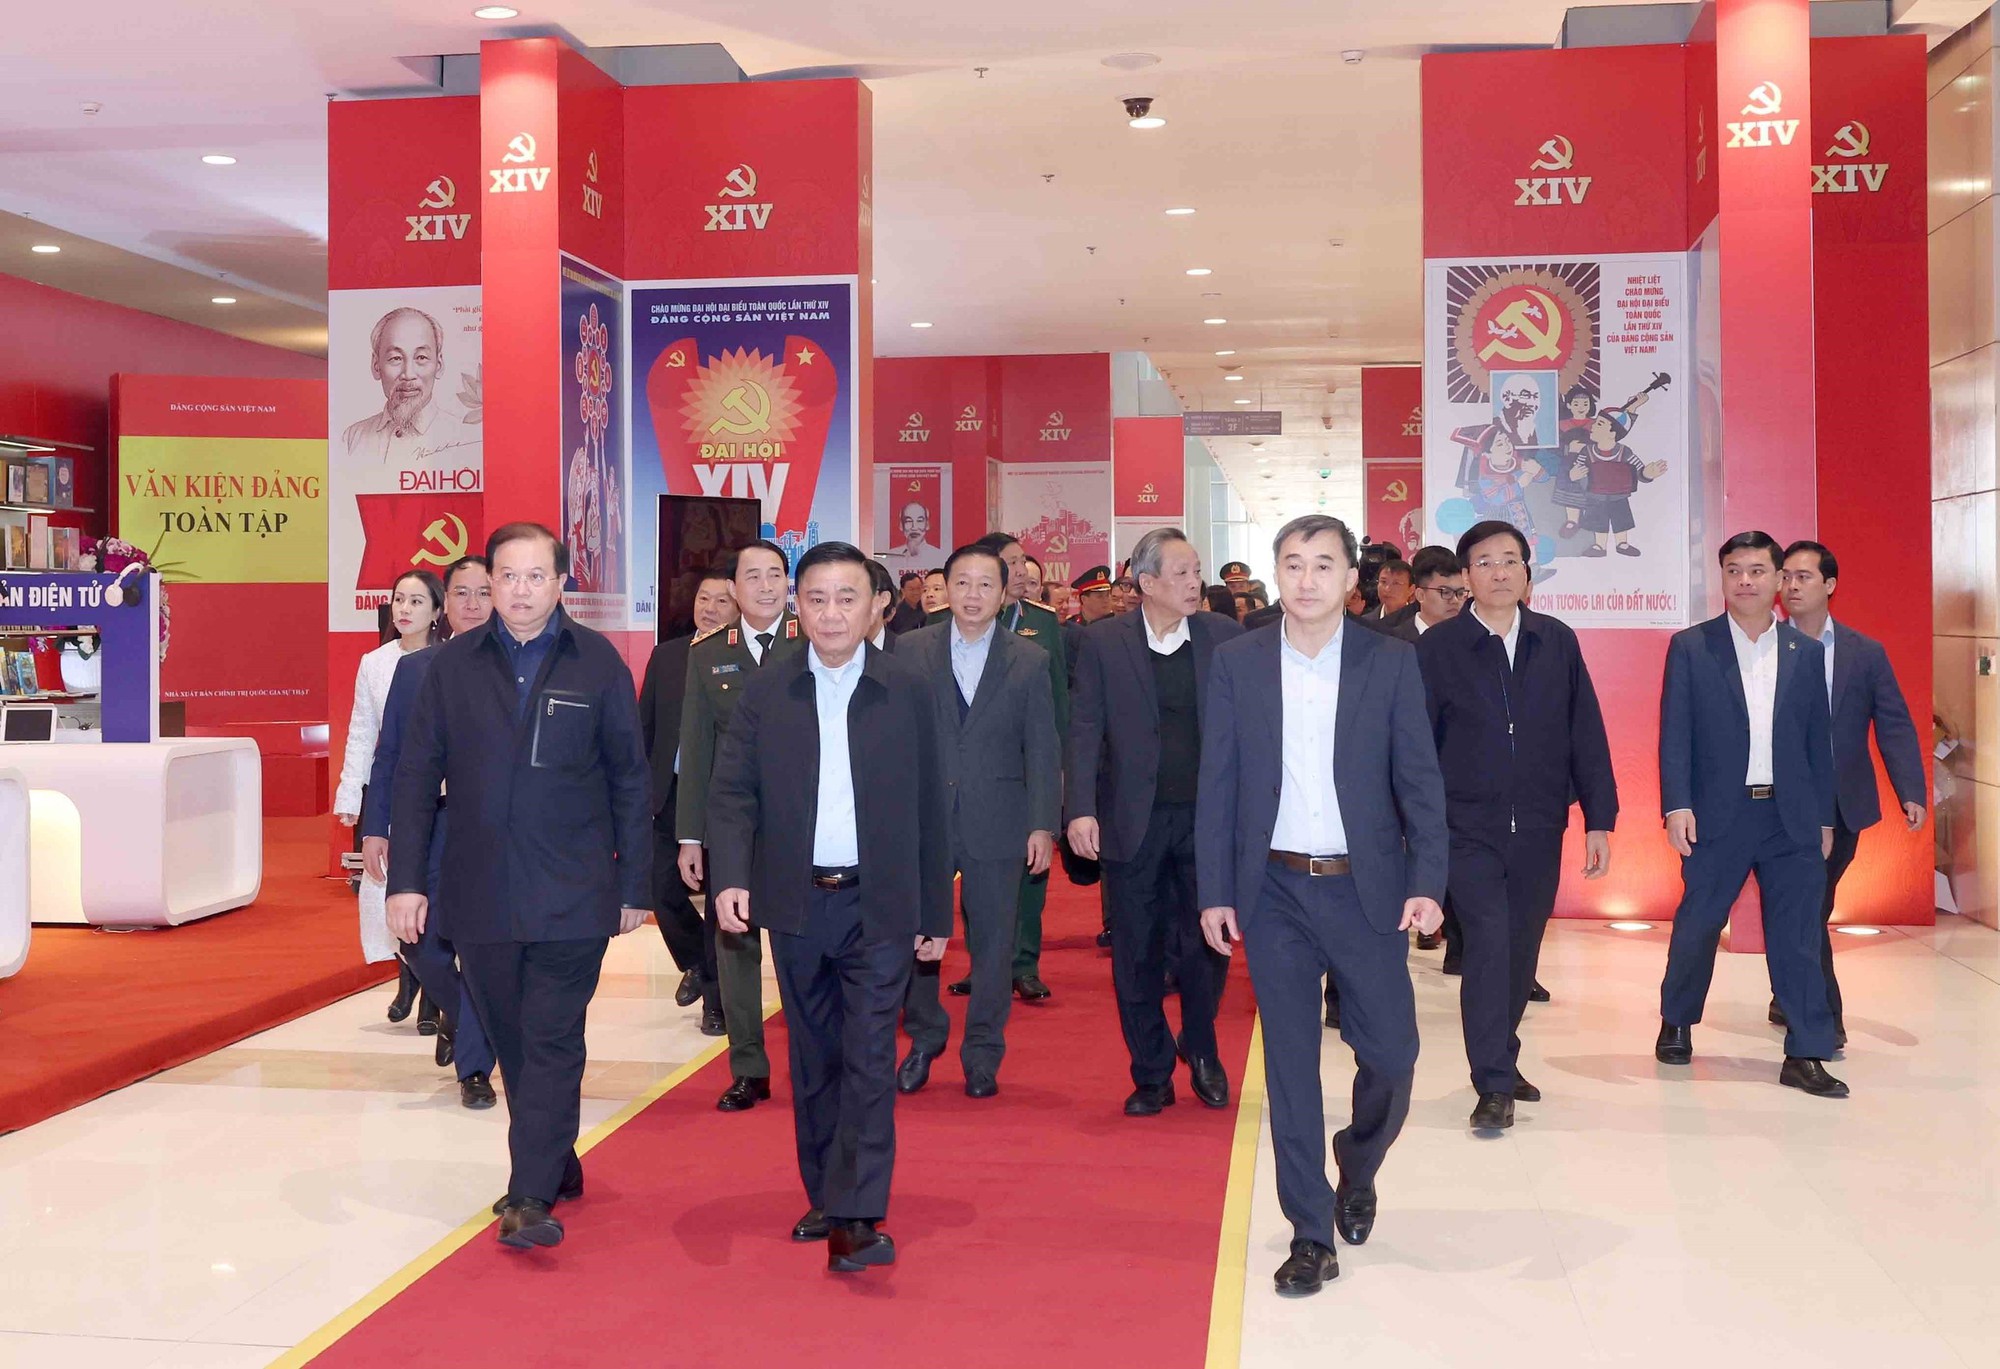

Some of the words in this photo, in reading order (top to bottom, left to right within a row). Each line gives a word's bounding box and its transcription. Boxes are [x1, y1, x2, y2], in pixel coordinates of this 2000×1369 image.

[1726, 119, 1800, 148] XIV
[489, 167, 551, 193] XIV
[1811, 163, 1889, 193] XIV
[582, 184, 603, 219] XIV
[1514, 176, 1592, 206] XIV
[405, 214, 472, 241] XIV
[704, 203, 774, 231] XIV
[1627, 275, 1646, 285] NHIỆT
[1647, 274, 1661, 285] LIỆT
[1625, 287, 1642, 296] CHÀO
[650, 314, 689, 324] ĐẢNG
[693, 313, 731, 325] CỘNG
[735, 311, 762, 322] SẢN
[765, 311, 795, 323] VIỆT
[800, 311, 830, 320] NAM
[651, 303, 669, 313] CHÀO
[670, 302, 691, 313] MỪNG
[692, 304, 704, 314] ĐẠI
[705, 303, 717, 314] HỘI
[718, 303, 730, 313] ĐẠI
[749, 300, 767, 311] TOÀN
[768, 299, 787, 311] QUỐC
[818, 300, 829, 309] XIV
[170, 403, 194, 411] ĐẢNG
[195, 404, 219, 413] CỘNG
[237, 404, 257, 414] VIỆT
[257, 405, 276, 413] NAM
[899, 429, 930, 442] XIV
[955, 420, 983, 431] XIV
[1039, 429, 1071, 441] XIV
[1401, 423, 1422, 436] XI
[700, 442, 737, 462] ĐẠI
[743, 439, 781, 462] HỘI
[125, 468, 177, 497] VĂN
[184, 472, 245, 504] KIỆN
[251, 469, 320, 499] ĐẢNG
[399, 470, 436, 491] ĐẠI
[440, 467, 480, 492] HỘI
[1137, 494, 1160, 503] XIV
[159, 506, 232, 533] TOÀN
[238, 509, 288, 539] TẬP
[1043, 561, 1071, 582] XIV
[29, 582, 73, 611] ĐIỆN
[78, 580, 103, 607] TỬ
[1591, 594, 1605, 610] LAI
[1607, 588, 1624, 611] CỦA
